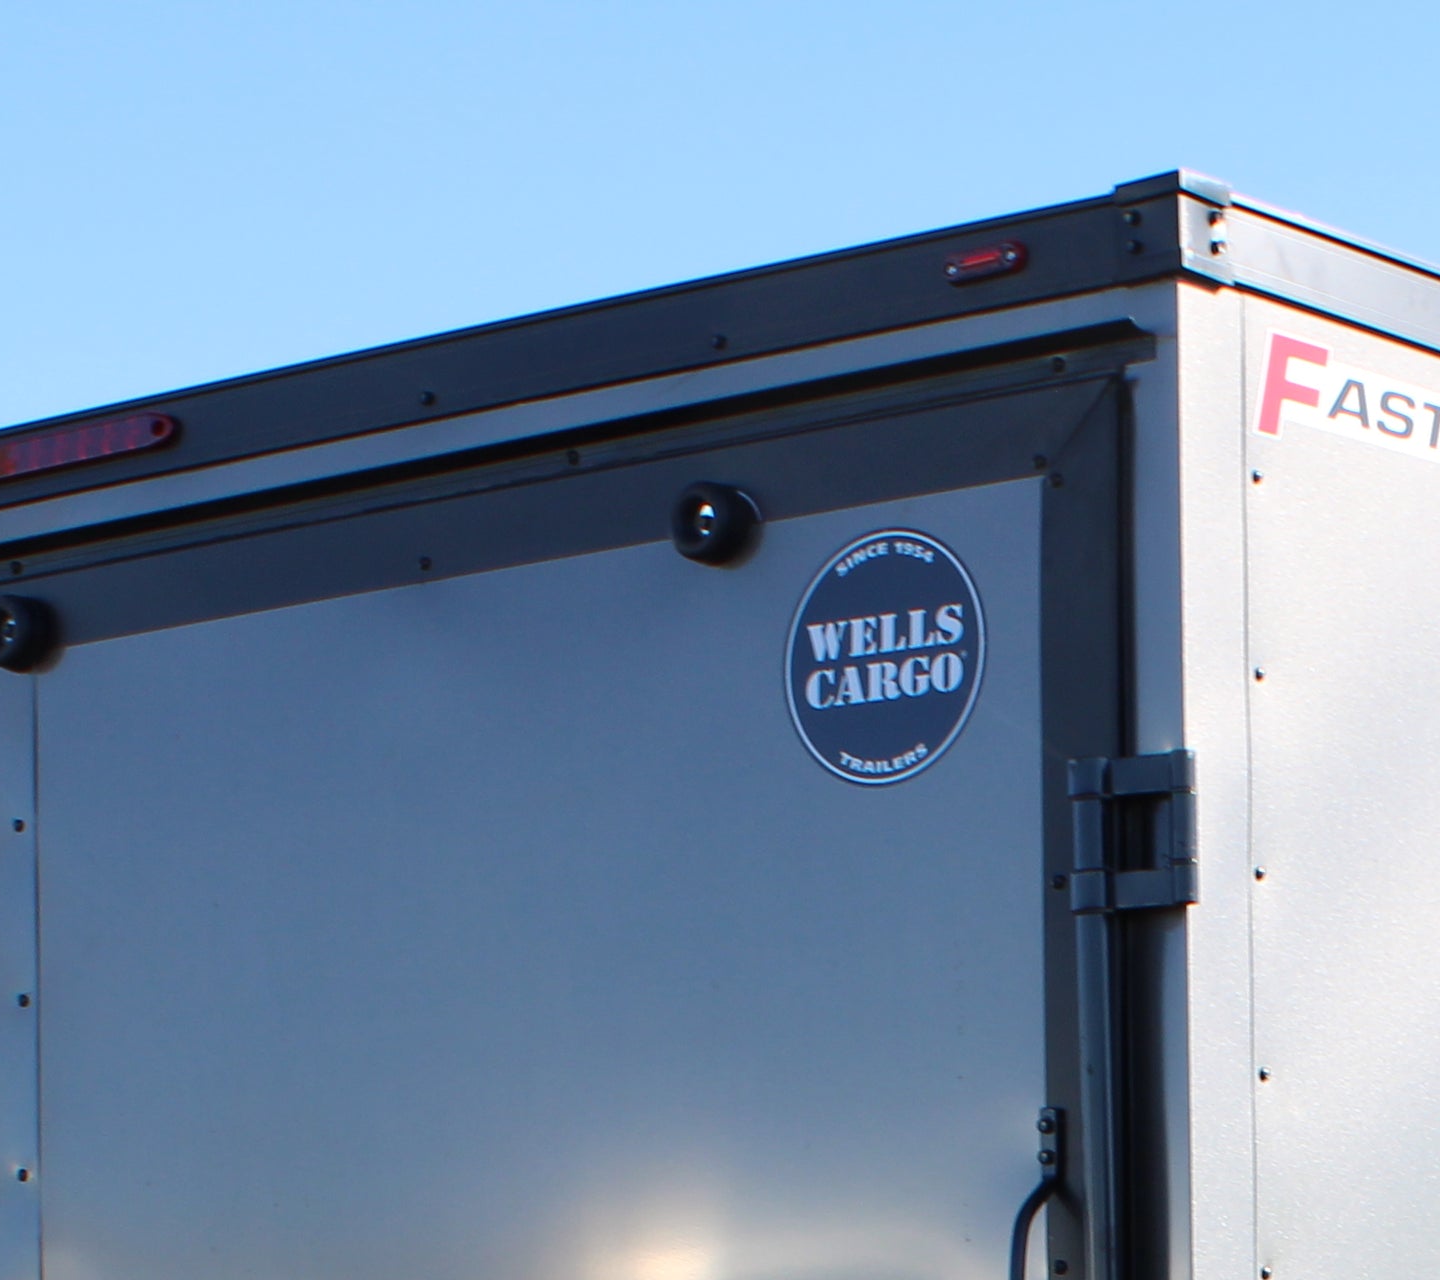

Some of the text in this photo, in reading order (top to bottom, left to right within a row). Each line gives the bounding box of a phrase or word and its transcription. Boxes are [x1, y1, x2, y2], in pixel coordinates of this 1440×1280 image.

[835, 541, 935, 577] SINCE 1954
[806, 602, 965, 662] WELLS
[805, 651, 964, 710] CARGO
[840, 743, 929, 773] TRAILERS
